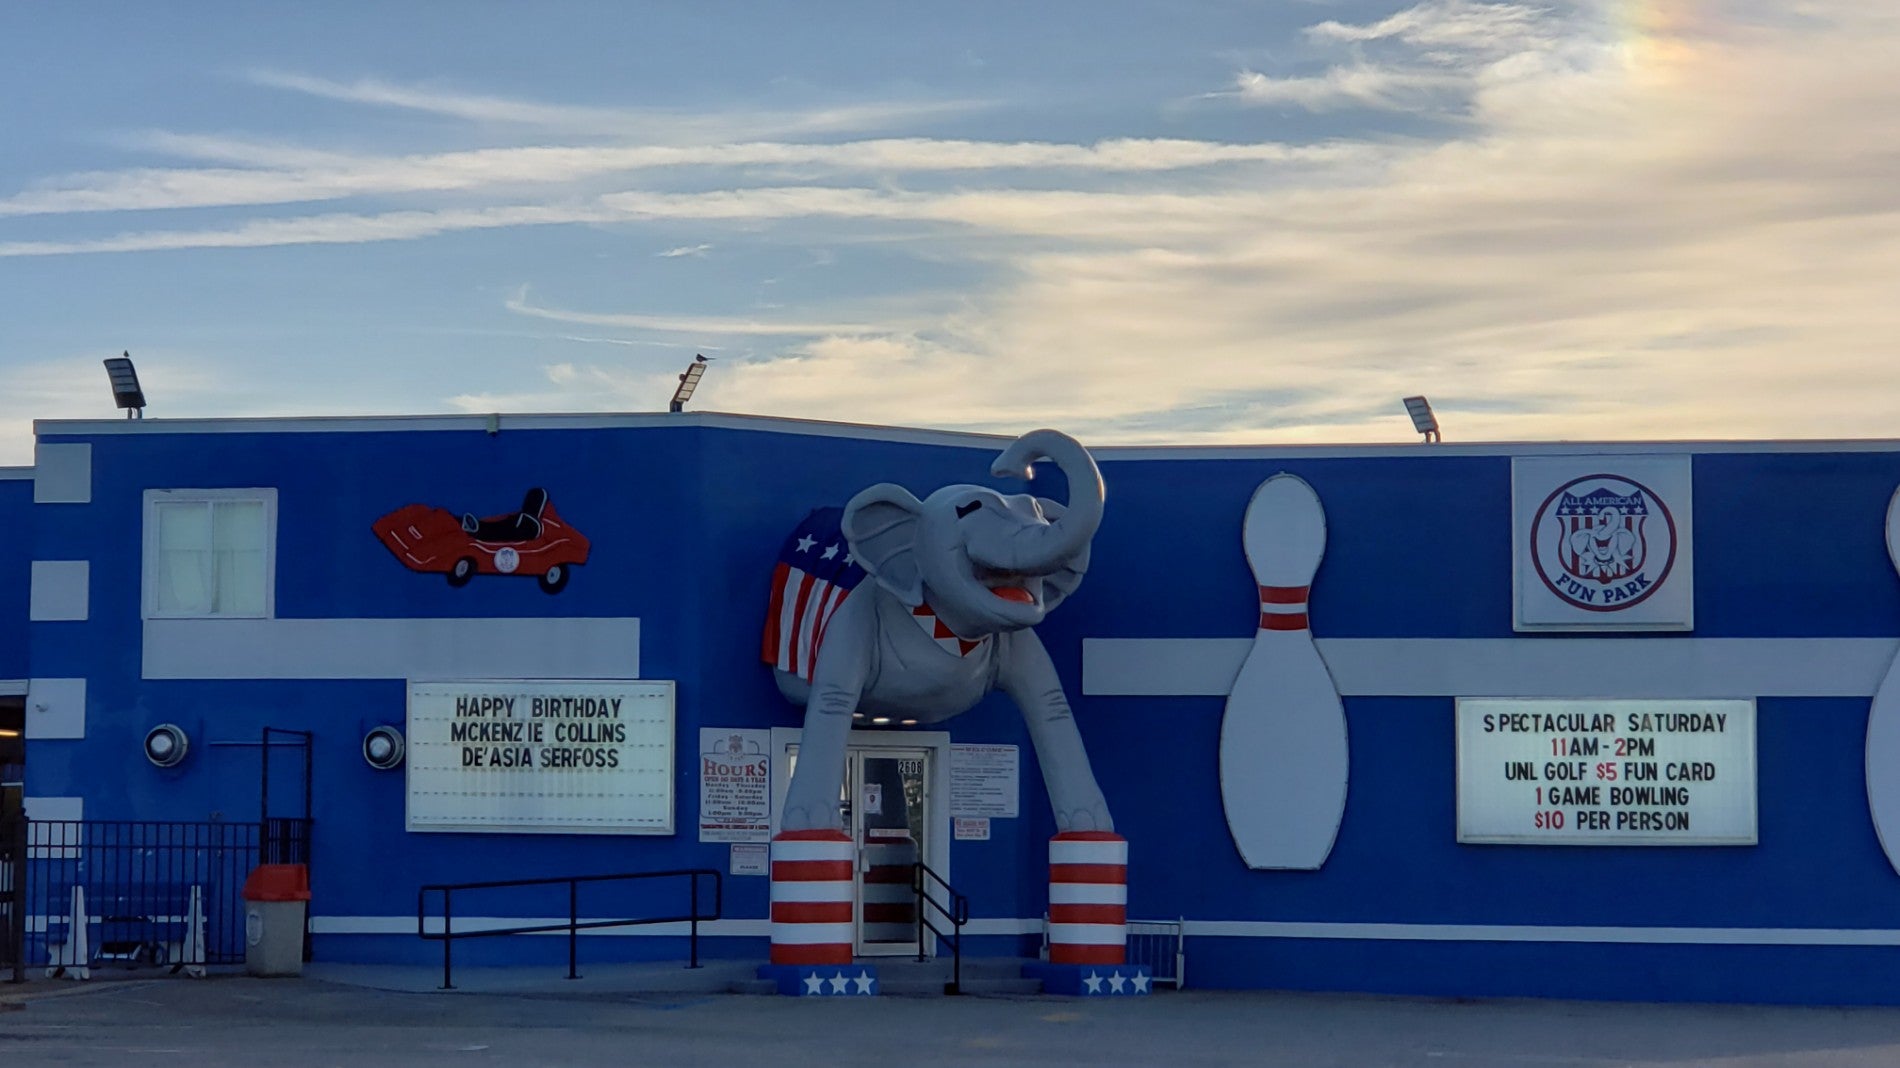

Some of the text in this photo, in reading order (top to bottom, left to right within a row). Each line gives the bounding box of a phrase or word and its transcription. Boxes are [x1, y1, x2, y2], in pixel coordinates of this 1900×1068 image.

[1562, 497, 1642, 506] ALL AMERICAN
[1556, 572, 1652, 603] FUN PARK
[456, 697, 622, 718] HAPPY BIRTHDAY
[451, 722, 626, 743] MCKENZIE COLLINS
[1483, 713, 1728, 733] SPECTACULAR SATURDAY
[462, 747, 619, 768] DE'ASIA SERFOSS
[1505, 762, 1716, 782] UNL GOLF $5 FUN CARD
[1535, 786, 1690, 806] 1 GAME BOWLING
[1534, 810, 1690, 831] $10 PER PERSON
